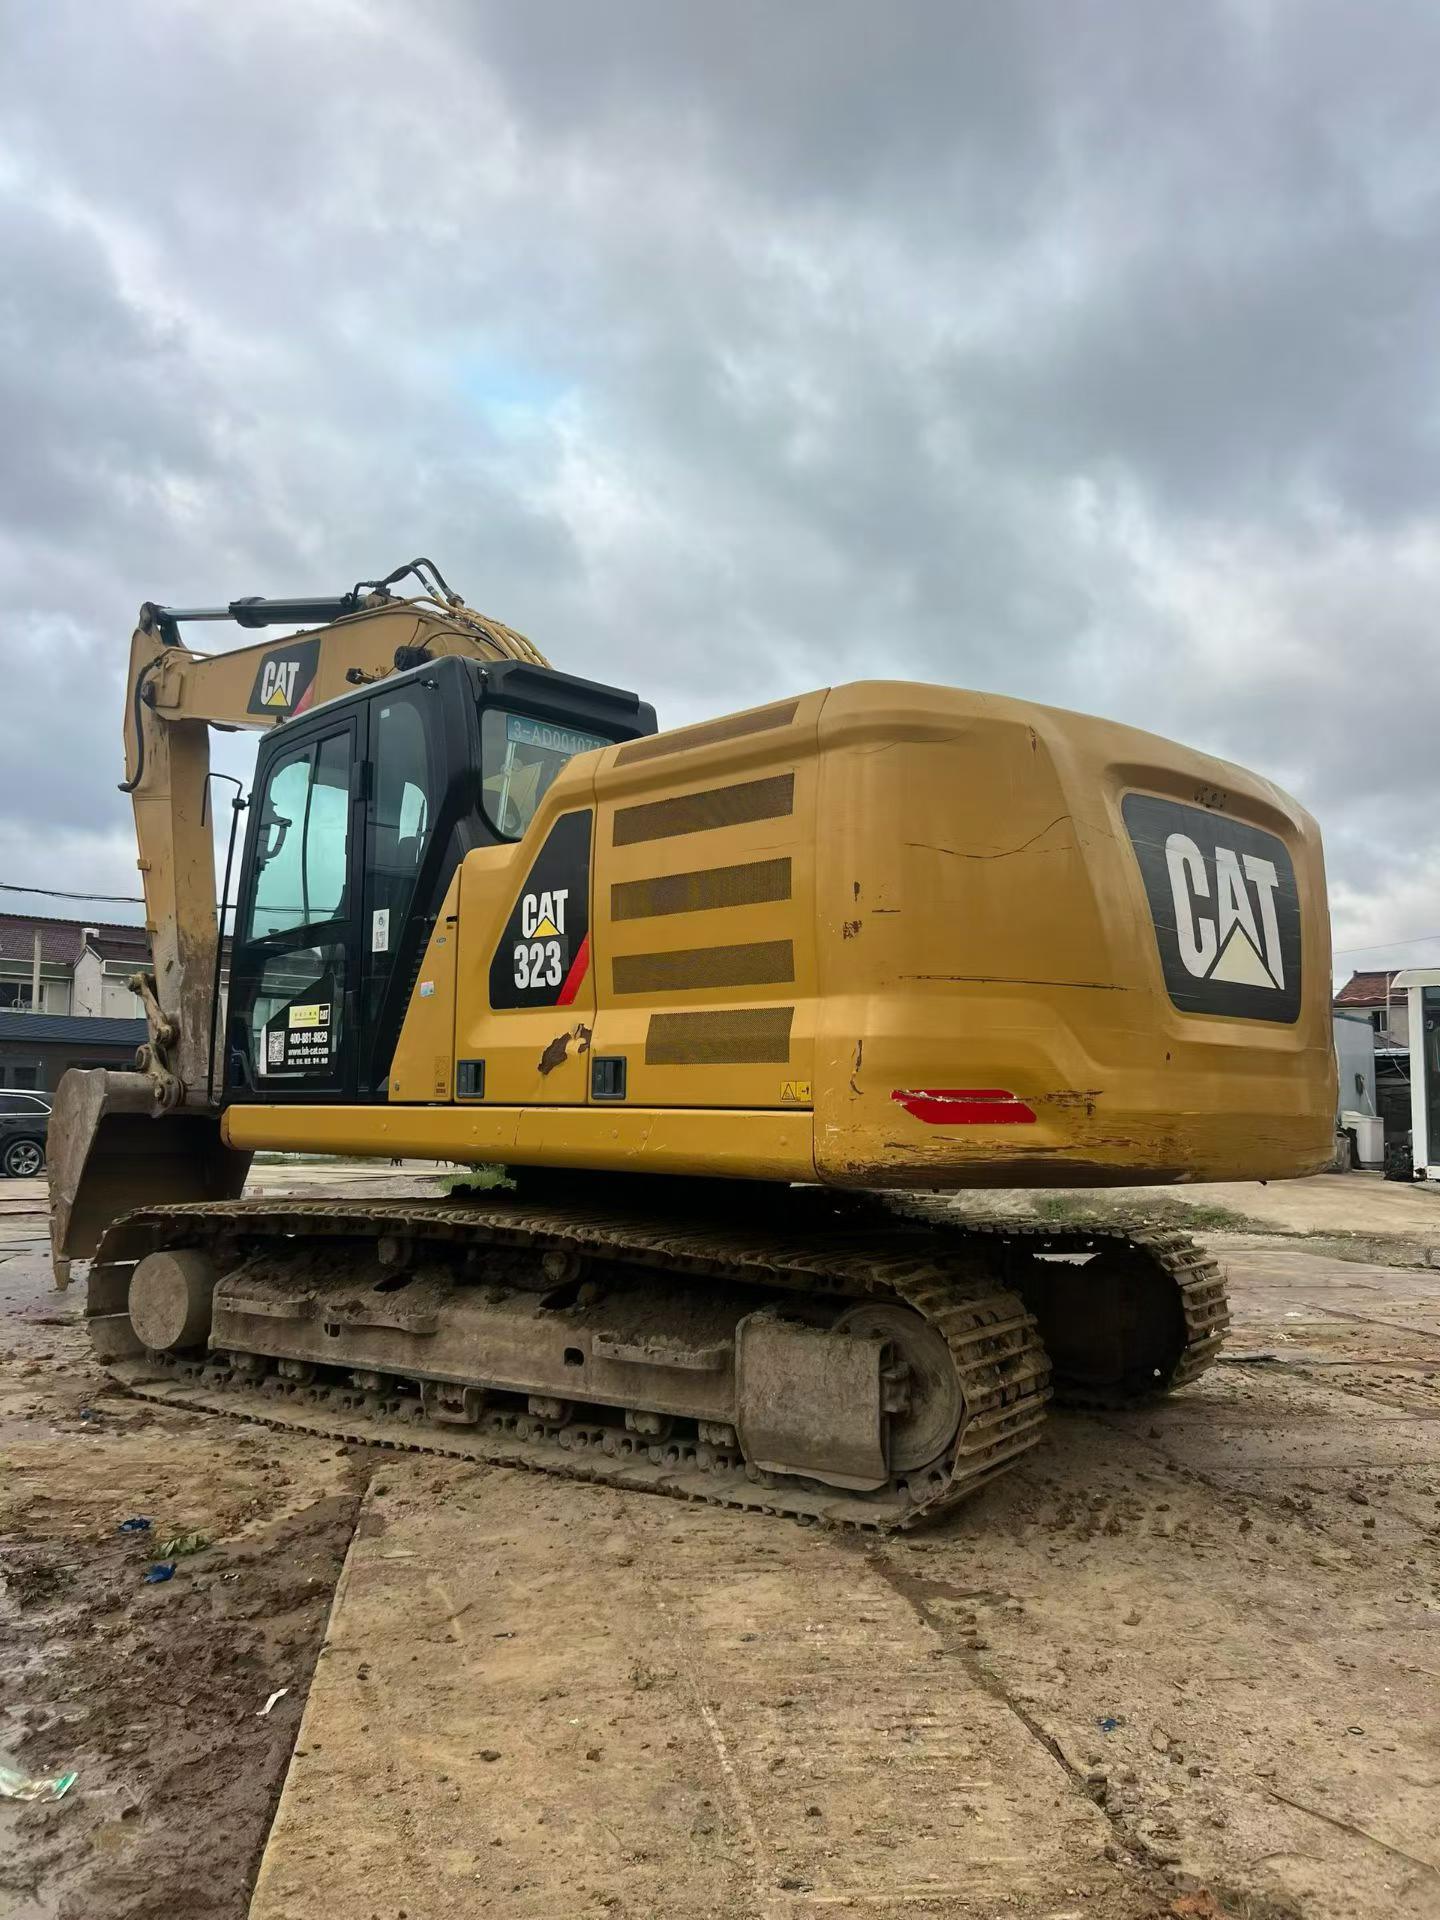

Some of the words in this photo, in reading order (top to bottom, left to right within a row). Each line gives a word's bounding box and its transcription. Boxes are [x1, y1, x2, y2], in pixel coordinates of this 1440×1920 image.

[261, 661, 300, 706] CAT
[522, 889, 568, 939] CAT
[1165, 833, 1285, 990] CAT
[514, 941, 562, 989] 323
